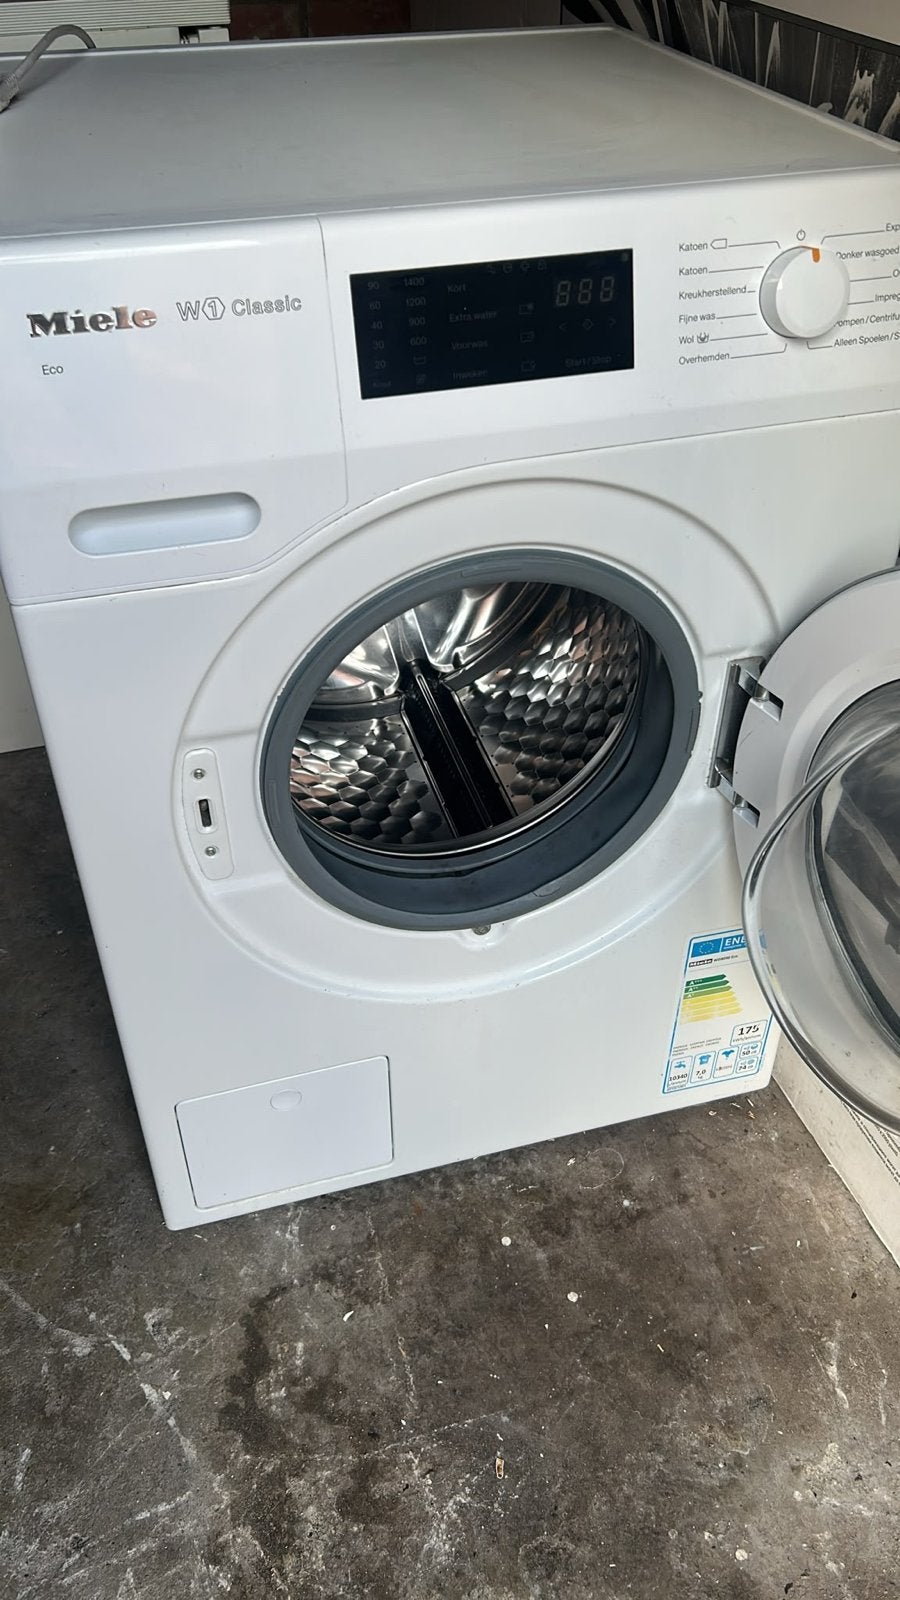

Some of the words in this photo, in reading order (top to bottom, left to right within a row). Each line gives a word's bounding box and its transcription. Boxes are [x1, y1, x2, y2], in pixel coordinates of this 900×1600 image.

[679, 241, 708, 252] Katoen
[864, 245, 900, 258] wasgoed
[679, 265, 708, 276] Katoen
[368, 281, 380, 290] 90
[404, 277, 425, 287] 1400
[679, 285, 747, 300] Kreukherstellend
[231, 295, 301, 317] Classic
[406, 297, 426, 307] 1200
[26, 306, 157, 338] Miele
[450, 312, 473, 323] Extra
[679, 314, 698, 325] Fijne
[699, 313, 716, 321] was
[833, 318, 865, 328] ompen
[679, 335, 695, 344] Wol
[834, 337, 858, 347] Alleen
[858, 333, 889, 345] Spoelen
[679, 352, 730, 365] Overhemden
[41, 364, 64, 376] Eco
[738, 1024, 760, 1036] 175
